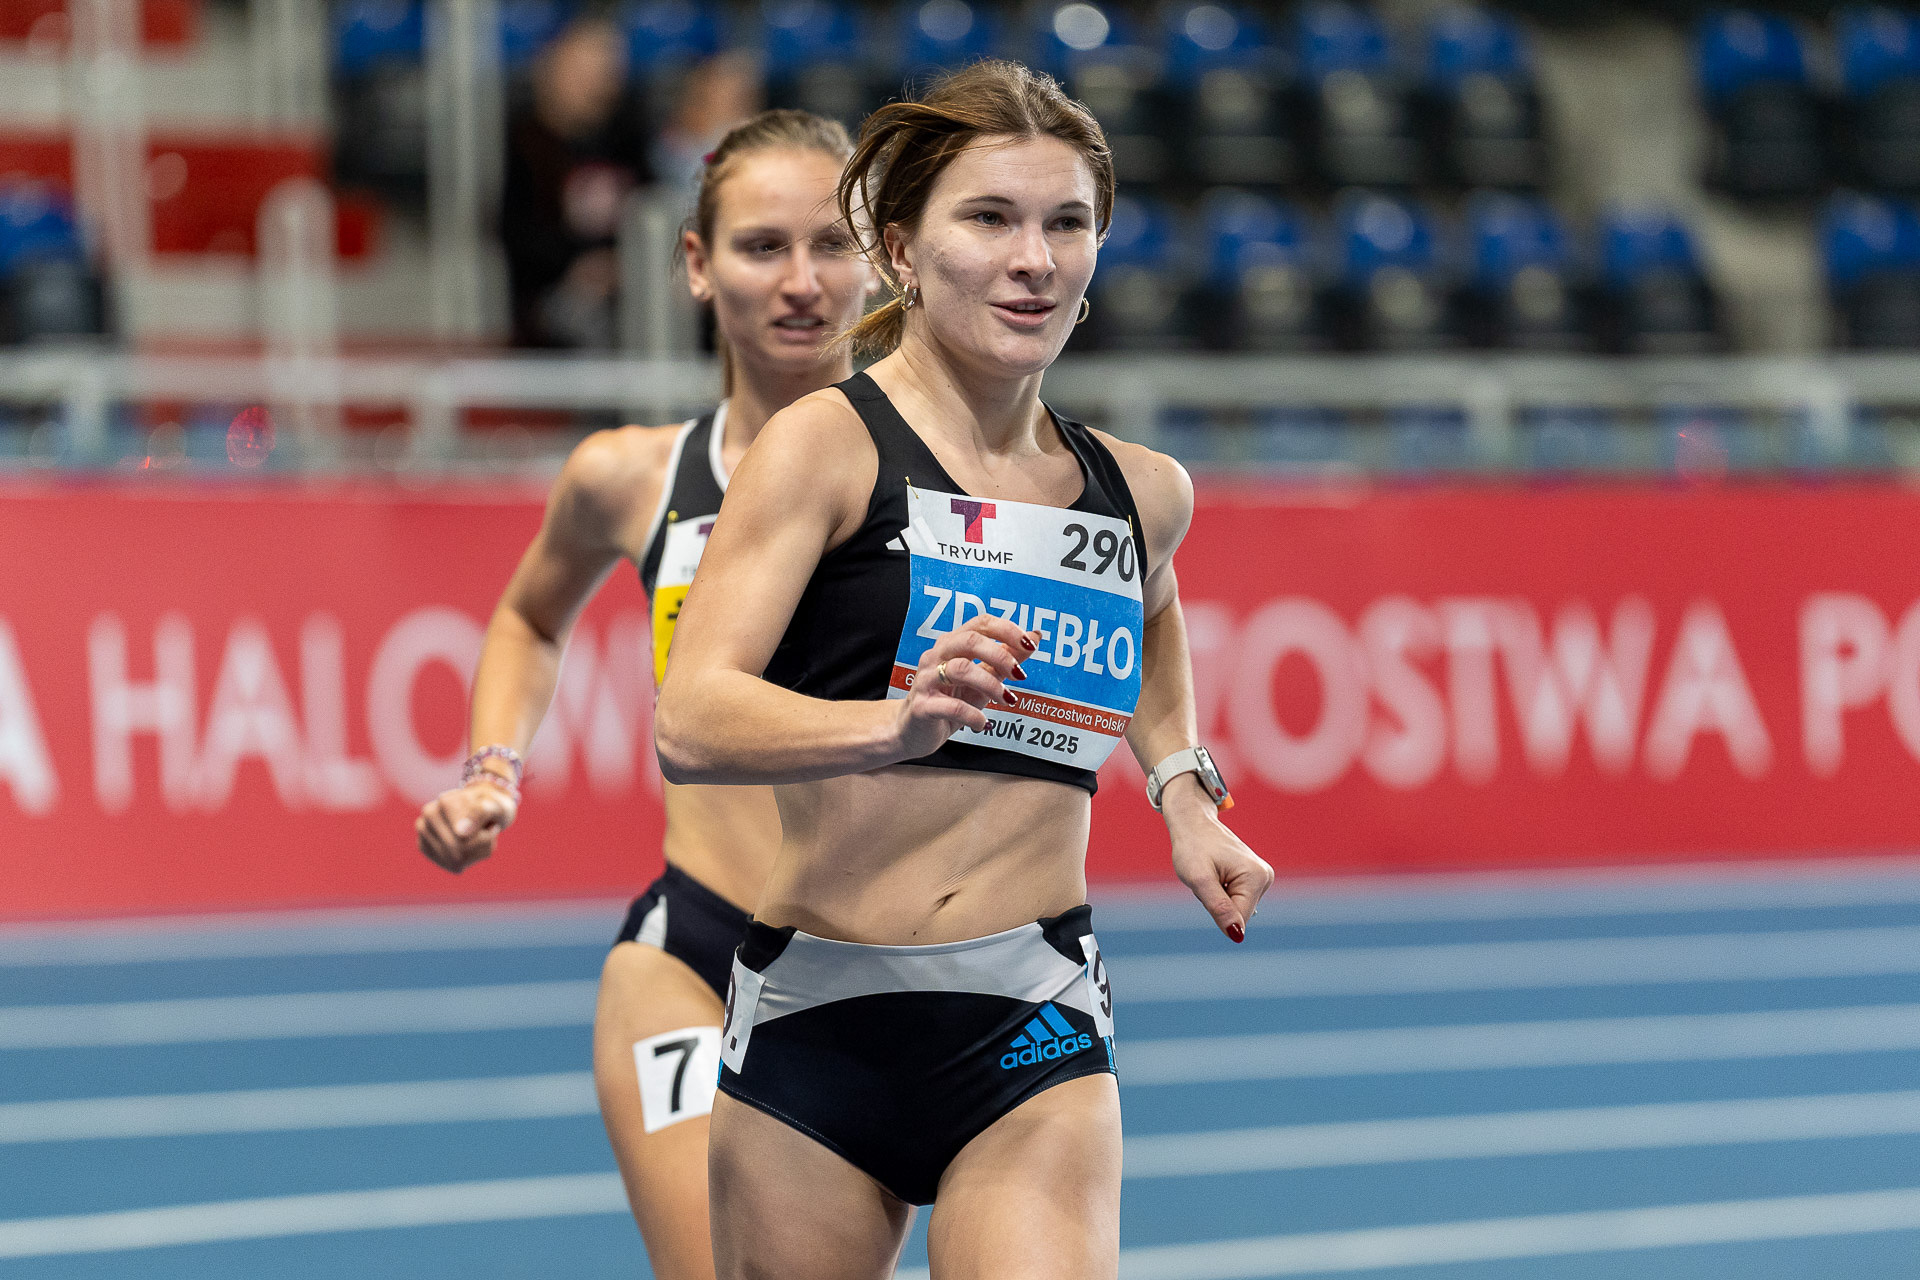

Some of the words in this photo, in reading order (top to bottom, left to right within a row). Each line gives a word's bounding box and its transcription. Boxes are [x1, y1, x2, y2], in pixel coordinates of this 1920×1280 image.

[937, 542, 1014, 565] TRYUMF
[1060, 523, 1135, 582] 290
[87, 606, 664, 814] HALOW
[1799, 588, 1920, 782] P
[1019, 697, 1092, 725] Mistrzostwa
[1094, 716, 1126, 733] Polski
[960, 717, 1025, 742] RUŃ
[1026, 727, 1079, 754] 2025
[1000, 1033, 1093, 1070] adidas
[653, 1035, 700, 1114] 7
